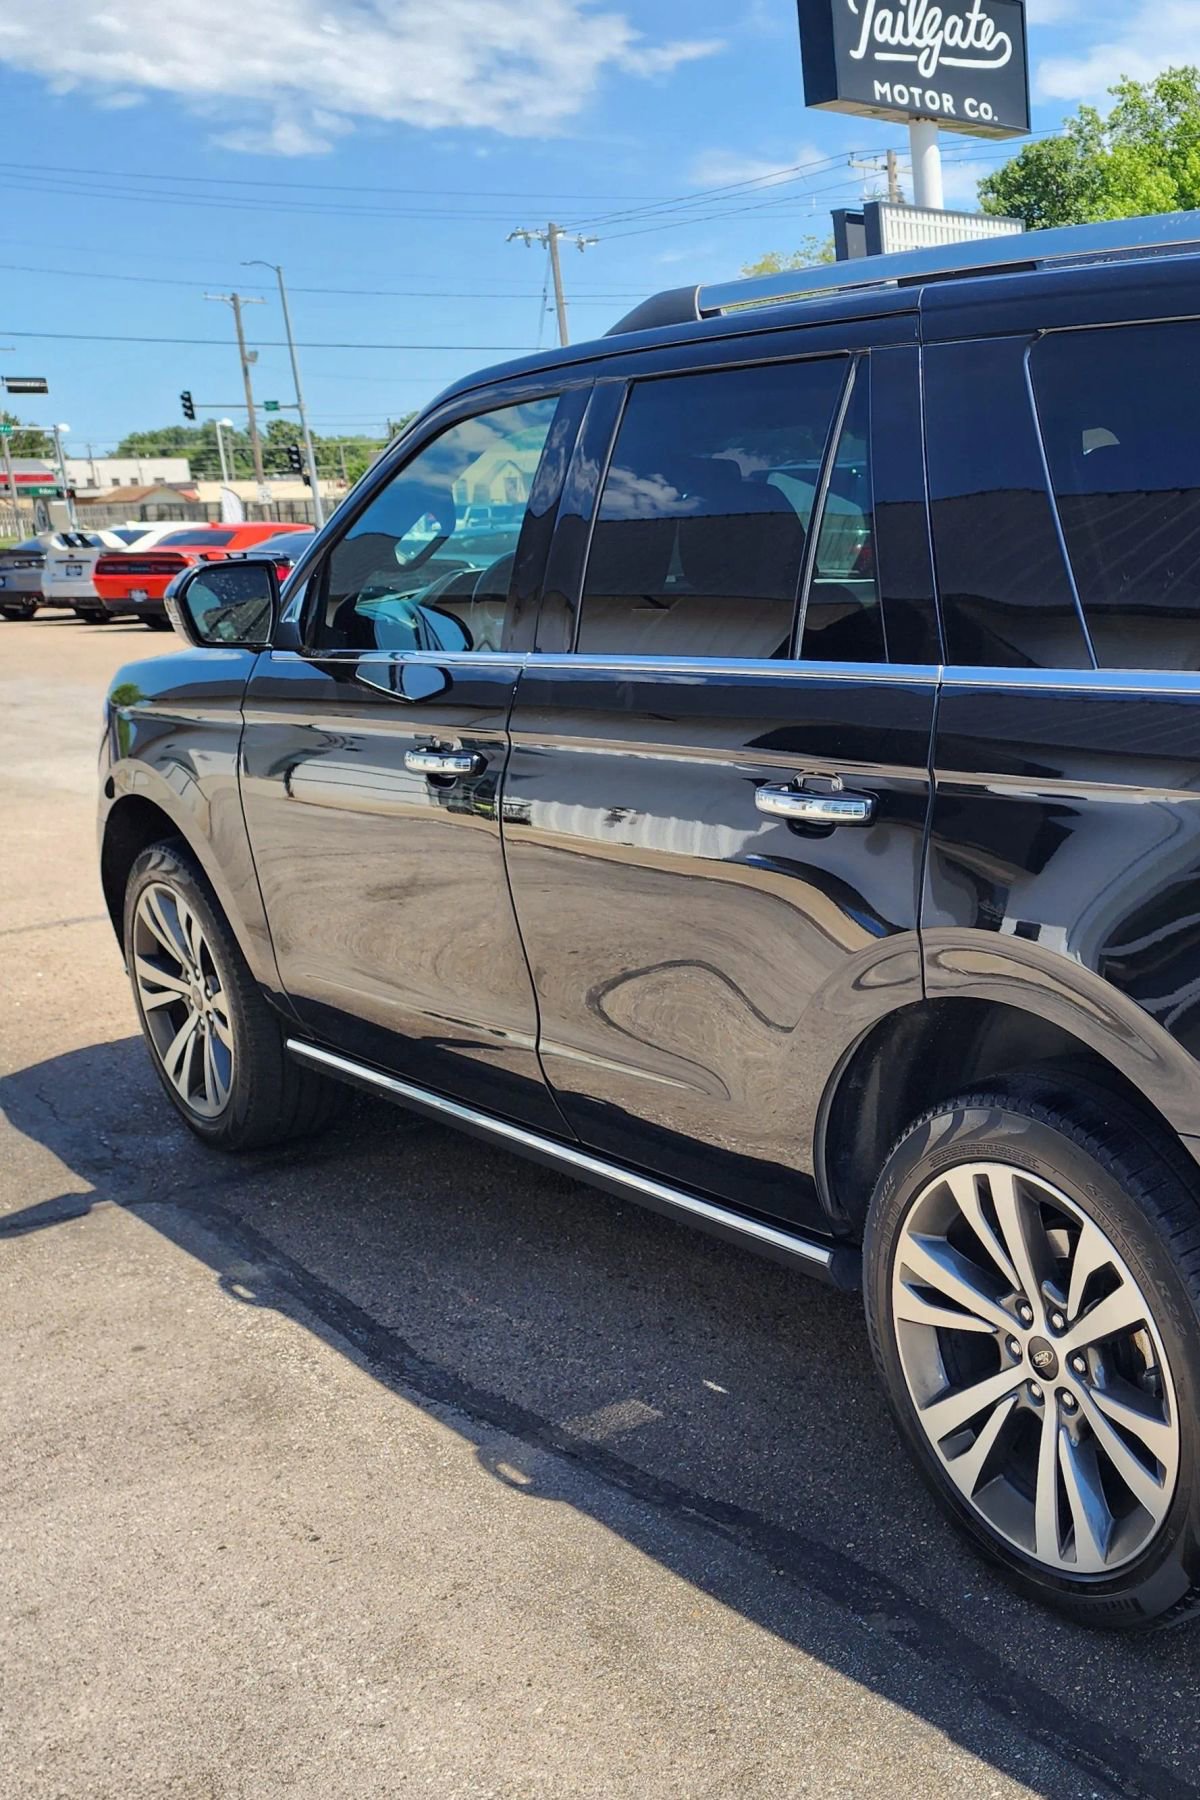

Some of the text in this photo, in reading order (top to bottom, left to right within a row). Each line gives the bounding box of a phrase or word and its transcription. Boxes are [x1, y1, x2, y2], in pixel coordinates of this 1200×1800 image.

[848, 0, 1012, 78] Tailgate
[873, 80, 999, 121] MOTOR CO.
